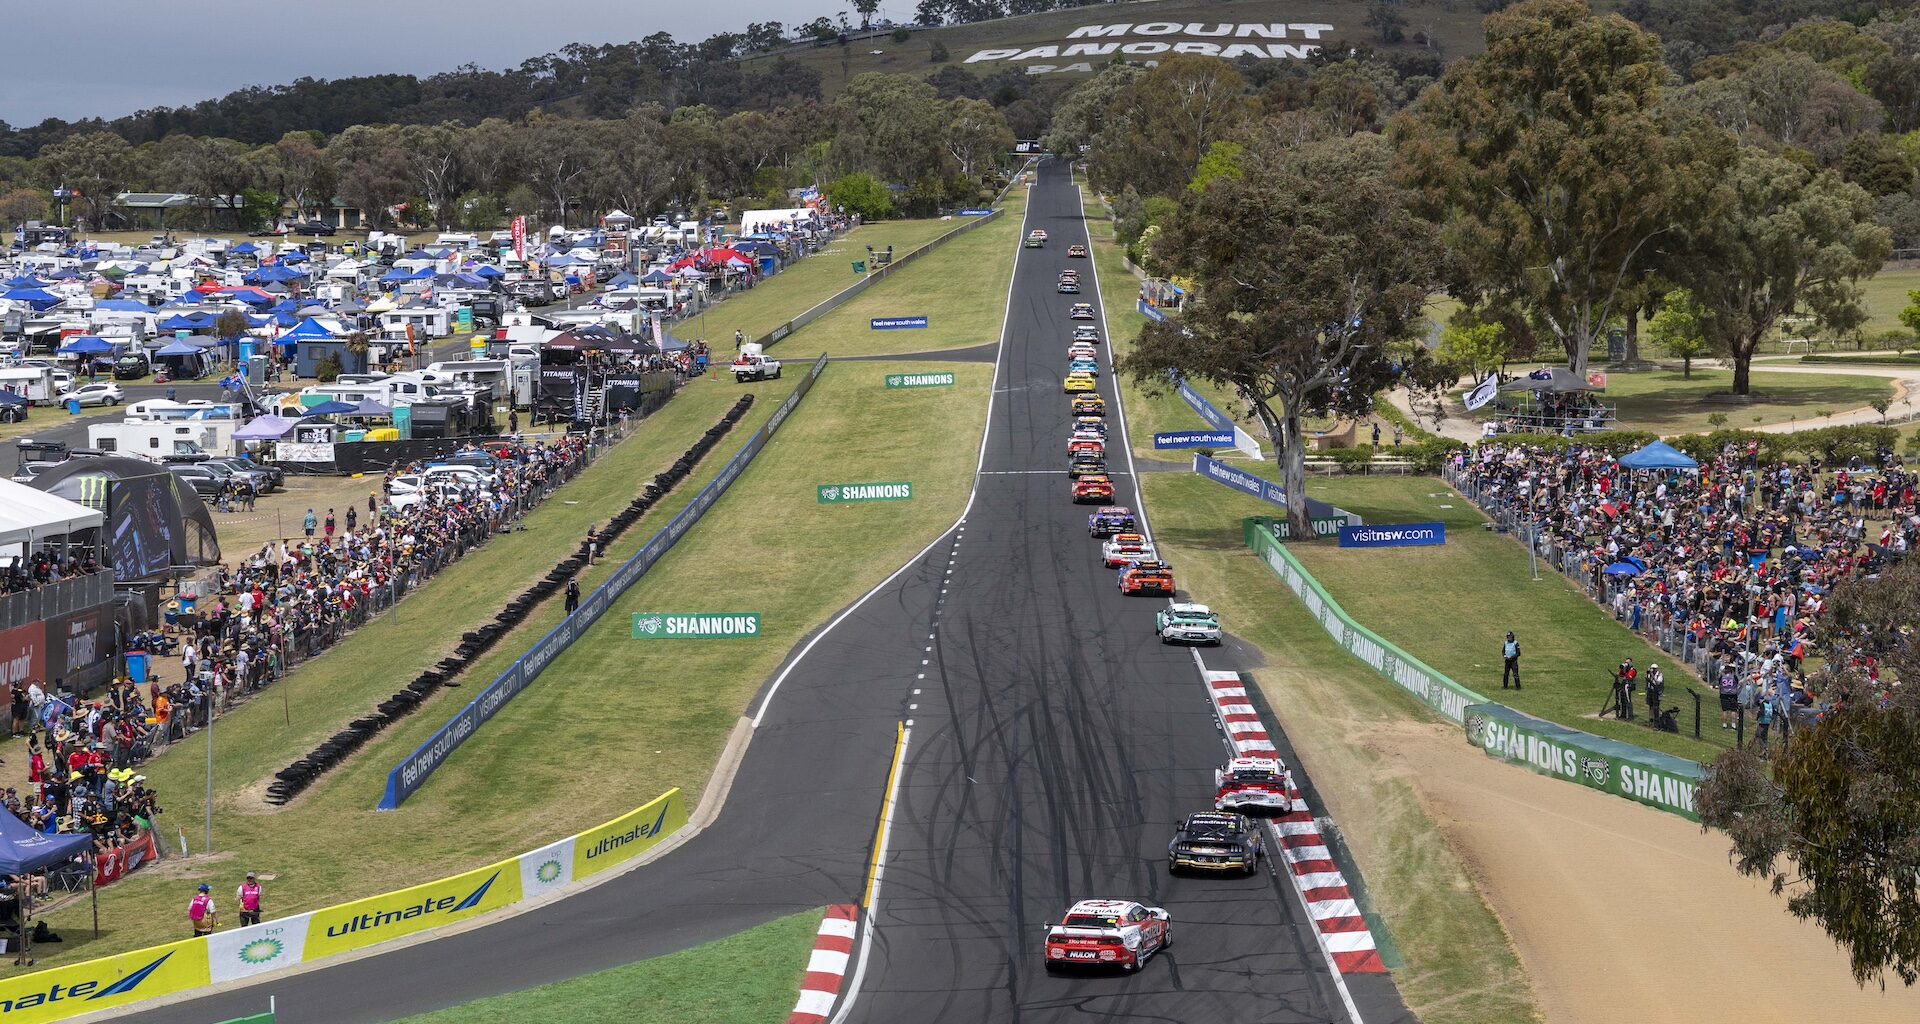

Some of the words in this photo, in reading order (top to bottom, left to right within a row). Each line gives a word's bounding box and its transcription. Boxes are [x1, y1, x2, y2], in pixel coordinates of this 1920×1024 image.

[1065, 22, 1334, 39] MOUNT
[962, 41, 1322, 63] PANORAM
[771, 325, 789, 342] TRAVEL
[903, 374, 953, 386] SHANNONS
[1158, 436, 1172, 444] feel
[1190, 434, 1212, 442] south
[1211, 434, 1233, 442] wales
[1209, 461, 1219, 477] feel
[1219, 468, 1230, 481] new
[1230, 472, 1245, 486] south
[1245, 478, 1260, 493] wales
[842, 484, 910, 500] SHANNONS
[1267, 486, 1286, 505] visitns
[1273, 519, 1346, 538] SHNONS
[1351, 528, 1434, 542] visitnsw.com
[666, 616, 757, 635] SHANNONS
[523, 653, 535, 678] feel
[534, 647, 545, 669] new
[544, 633, 559, 659] south
[558, 626, 571, 648] wales
[1352, 631, 1385, 672] SHANNONS
[1394, 657, 1430, 700] SHANNONS
[1722, 678, 1734, 687] 34
[479, 673, 517, 718] visitnsw.com
[1441, 687, 1474, 723] SHAN
[402, 757, 418, 788] feel
[418, 747, 434, 772] new
[434, 727, 454, 760] south
[453, 715, 472, 742] wales
[1485, 721, 1577, 778] SHANNONS
[1620, 764, 1697, 812] SHANN
[586, 821, 650, 860] ultimate
[551, 849, 562, 859] bp
[326, 892, 457, 939] ultimate
[266, 927, 284, 936] bp
[1069, 951, 1096, 959] NULON
